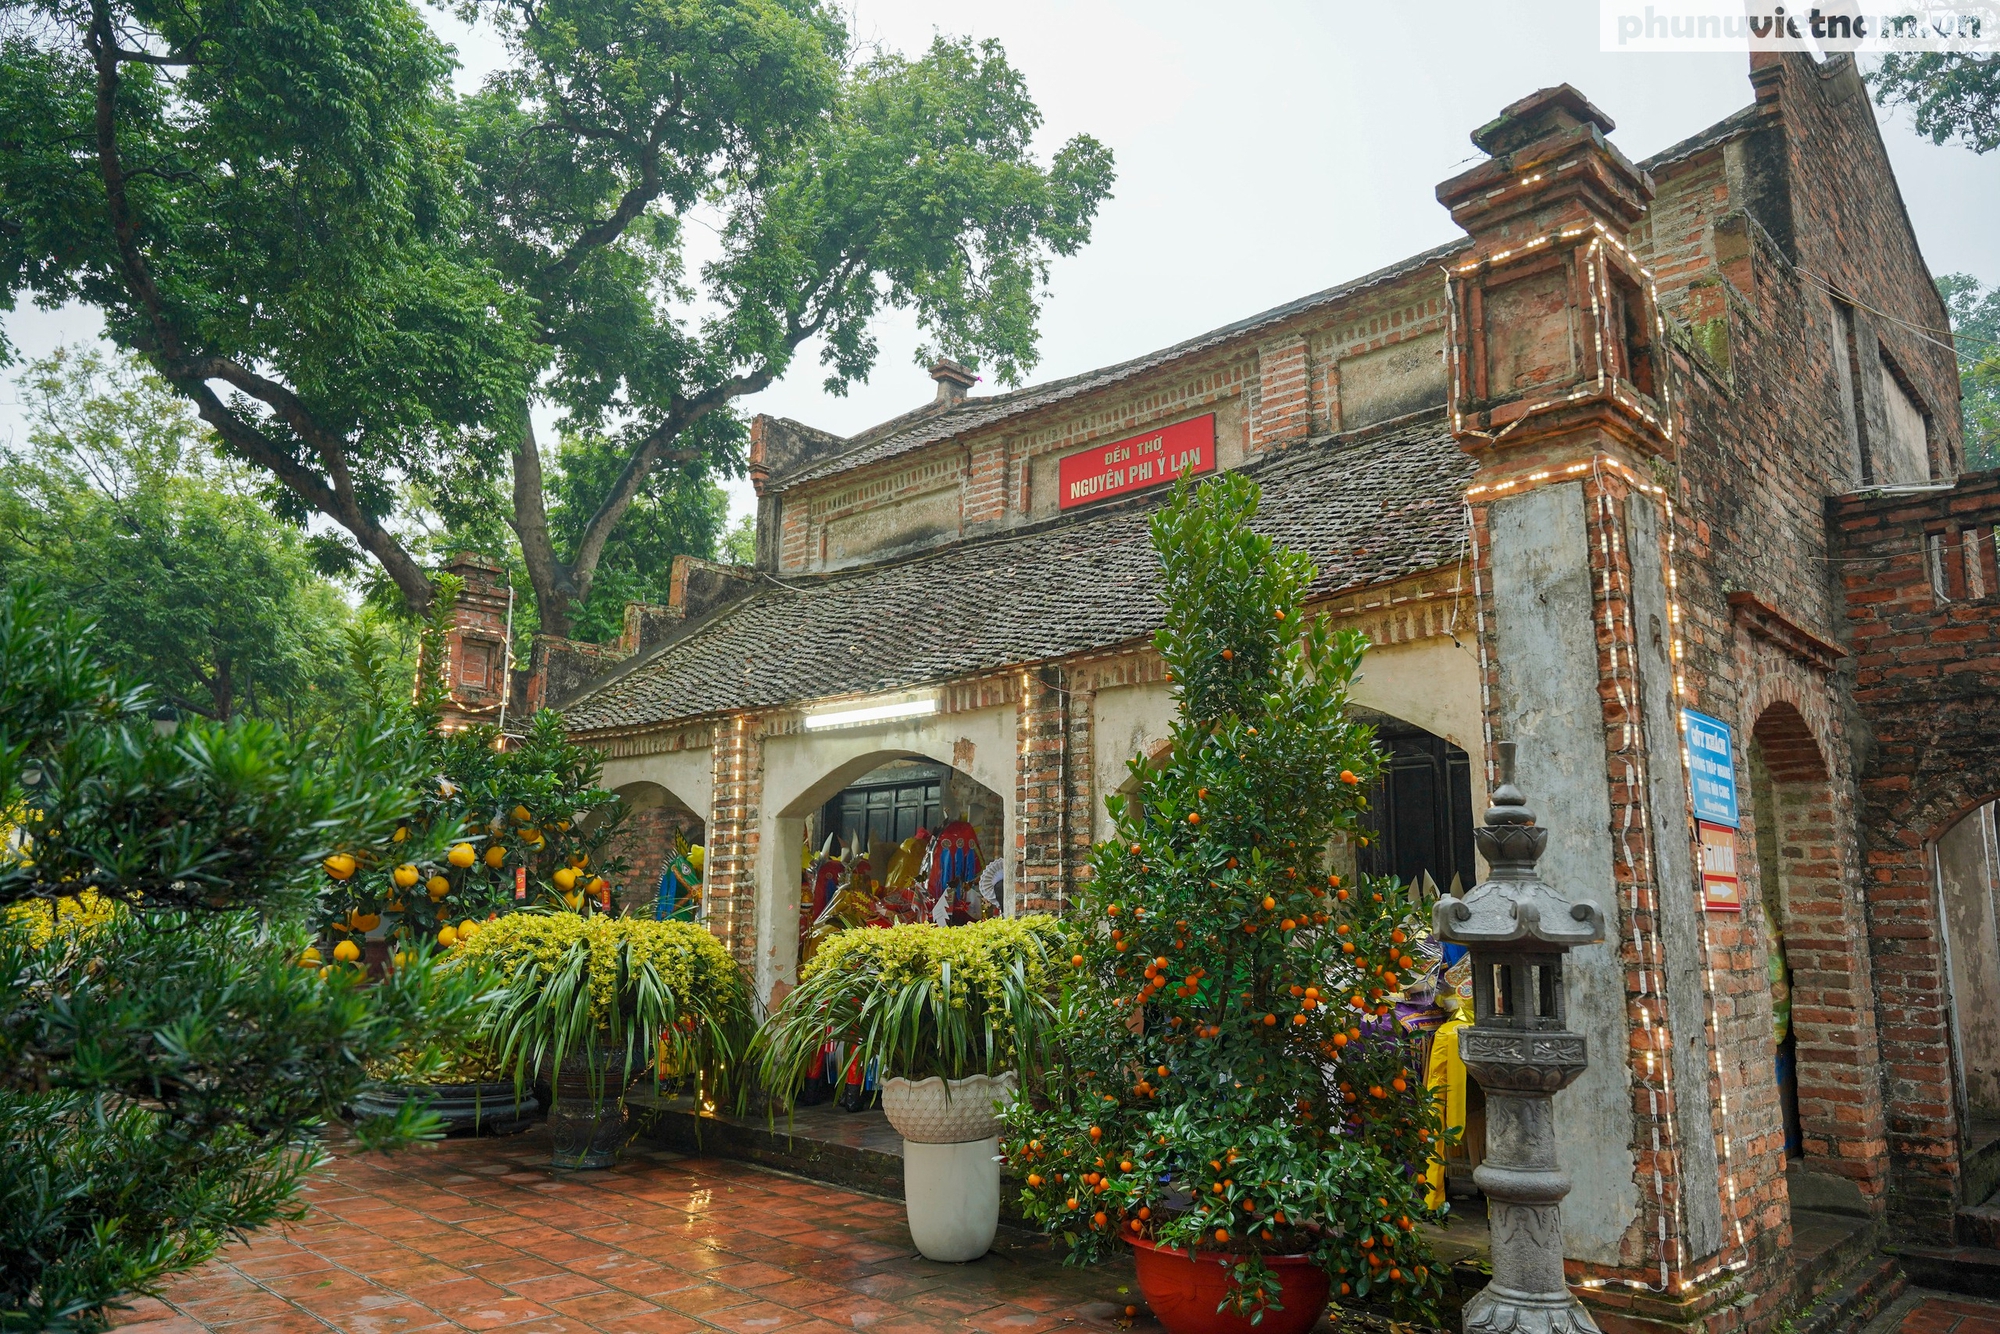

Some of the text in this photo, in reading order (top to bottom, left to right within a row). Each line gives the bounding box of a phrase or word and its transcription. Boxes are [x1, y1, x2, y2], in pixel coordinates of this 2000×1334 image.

[1104, 434, 1164, 466] ĐỀN THỜ
[1070, 447, 1201, 500] NGUYÊN PHI Ỷ LAN
